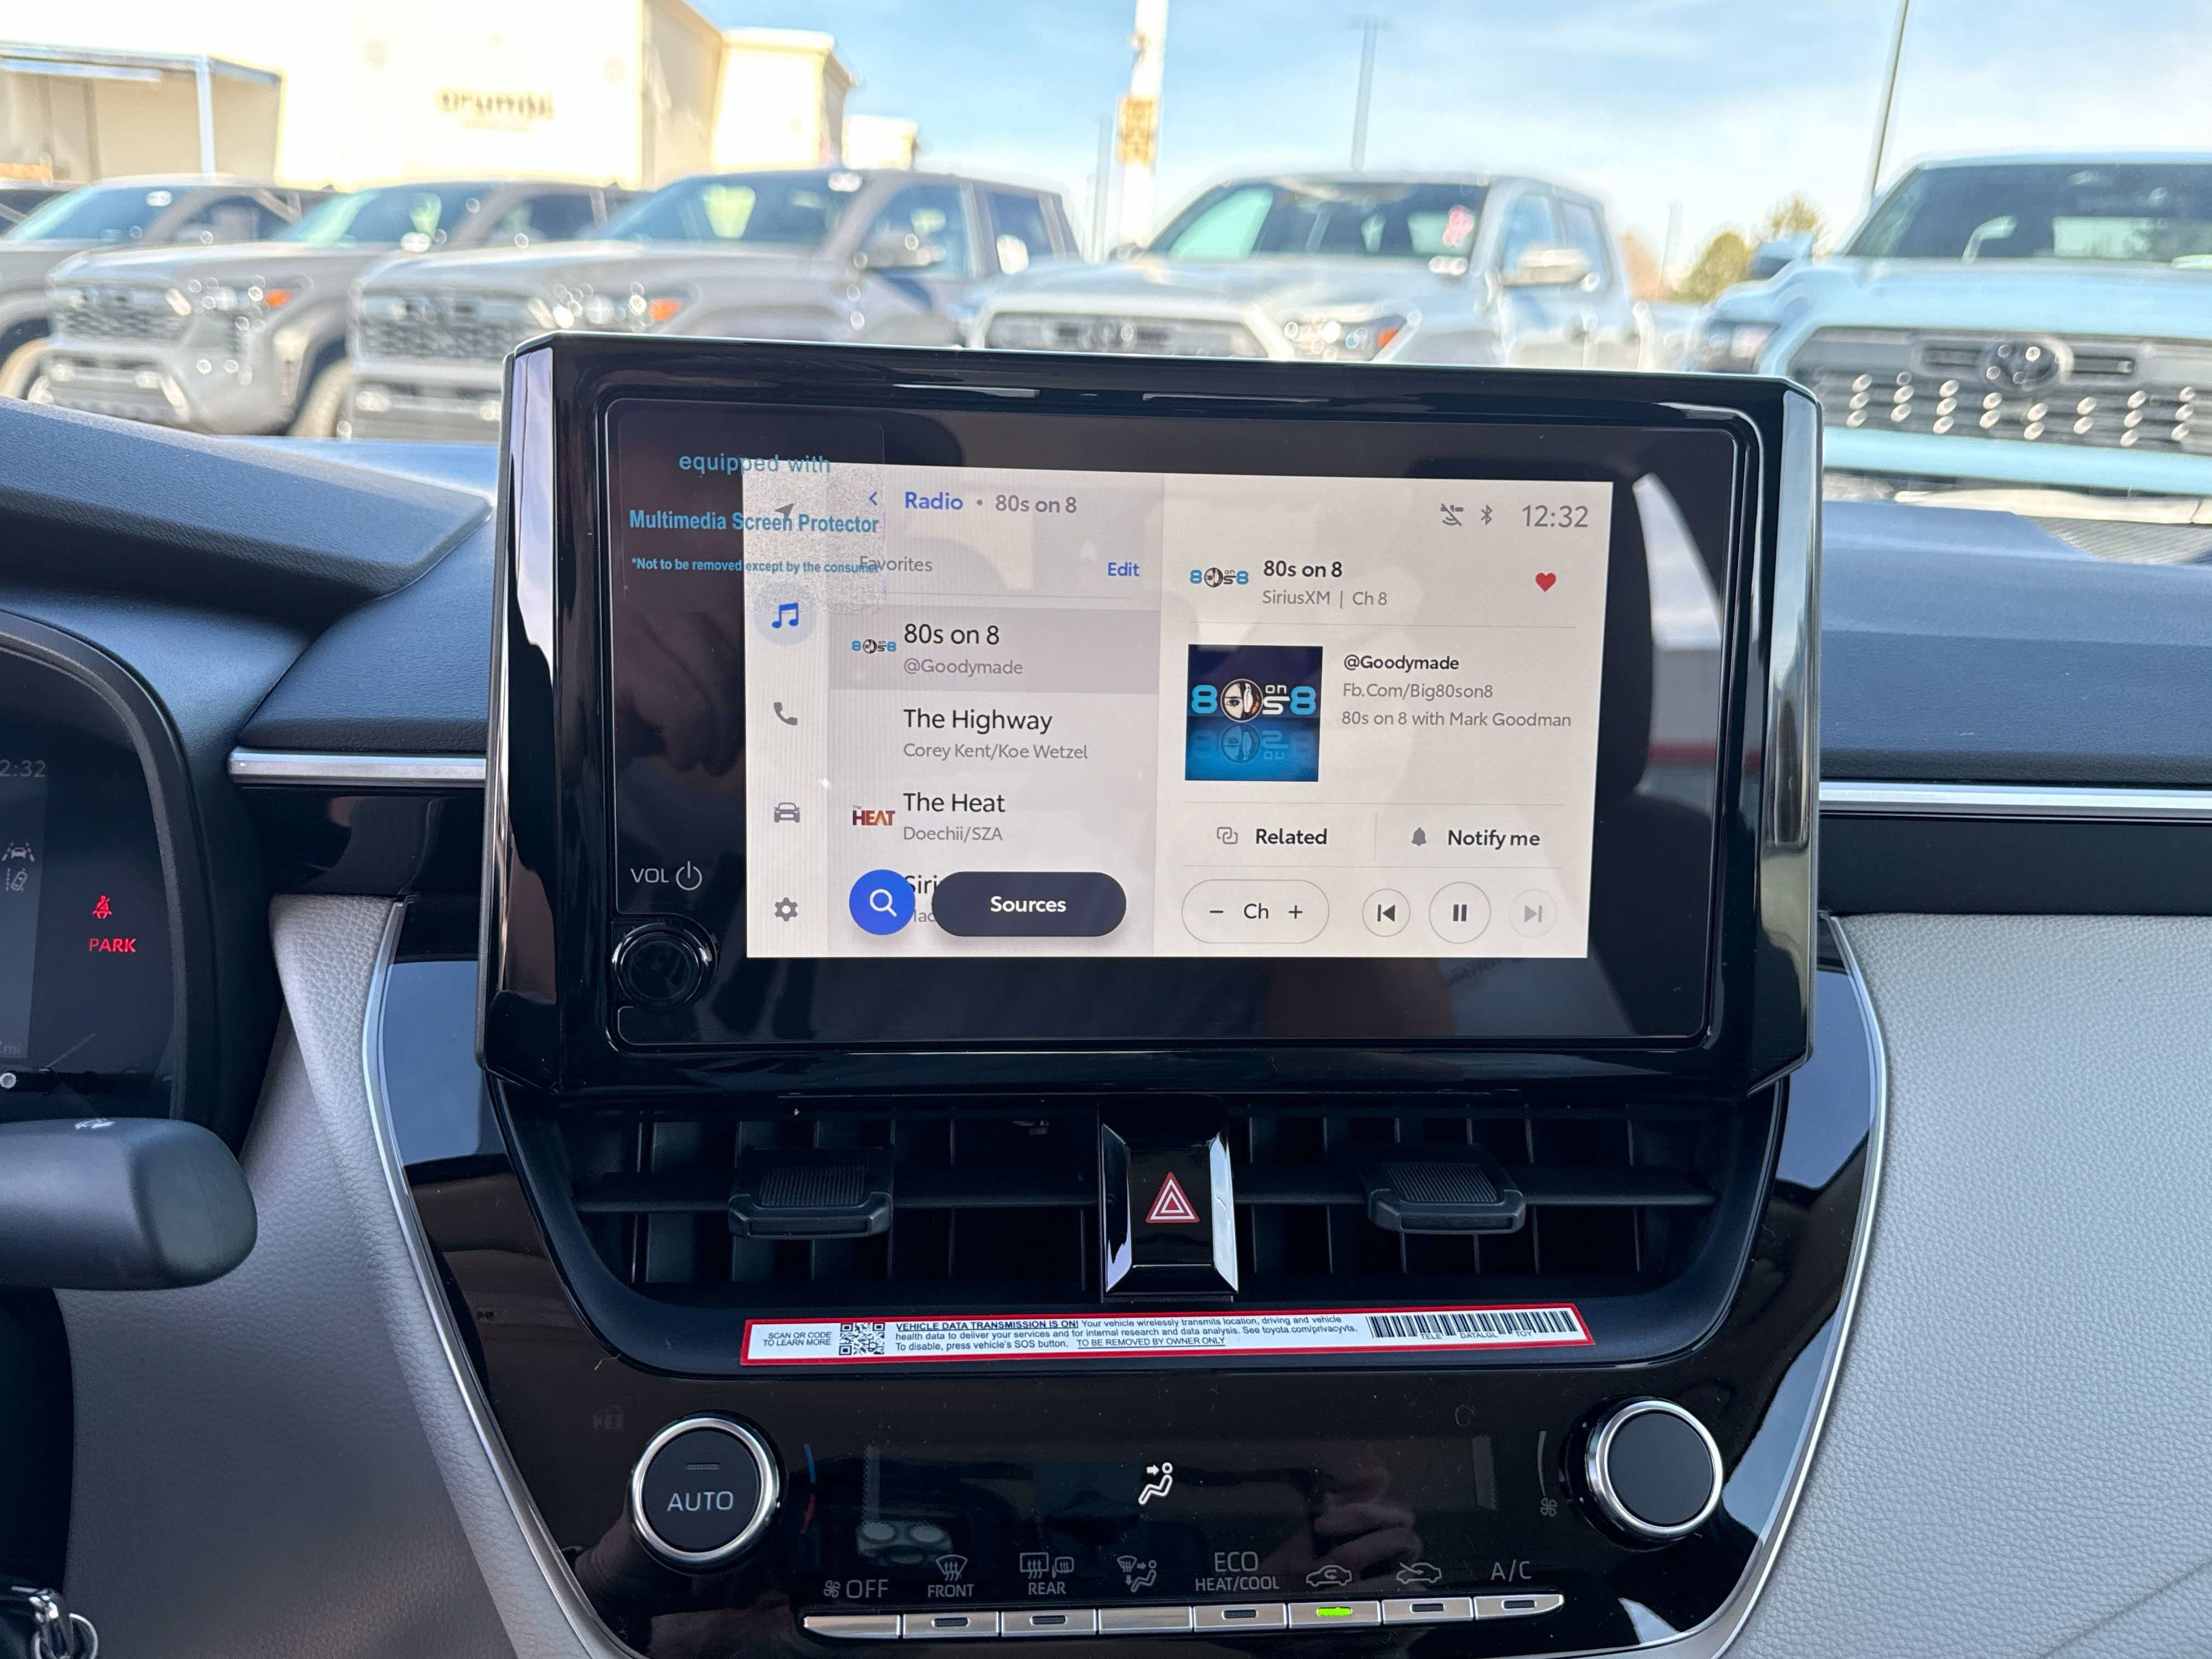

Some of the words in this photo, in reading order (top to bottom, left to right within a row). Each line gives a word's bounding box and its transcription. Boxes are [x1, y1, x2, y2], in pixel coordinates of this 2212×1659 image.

[679, 453, 778, 475] equipped
[788, 455, 830, 473] with
[905, 492, 963, 510] Radio
[996, 495, 1029, 512] 80s
[1035, 500, 1060, 513] on
[1066, 496, 1077, 513] 8
[630, 510, 726, 530] Multimedia
[732, 512, 792, 531] Screen
[799, 514, 879, 533] Protector
[1522, 505, 1589, 528] 12:32
[660, 560, 672, 570] to
[675, 558, 689, 571] be
[692, 560, 742, 571] removed
[746, 561, 783, 574] except
[786, 561, 800, 574] by
[803, 561, 821, 572] the
[860, 556, 933, 572] Favorites
[1108, 562, 1139, 577] Edit
[1263, 561, 1296, 578] 80s
[1302, 565, 1327, 578] on
[1331, 561, 1343, 578] 8
[1262, 589, 1330, 605] SiriusXM
[1352, 591, 1374, 605] Ch
[1378, 591, 1387, 606] 8
[904, 624, 944, 644] 80s
[951, 629, 979, 645] on
[987, 625, 1000, 645] 8
[904, 658, 1023, 678] @Goodymade
[1344, 655, 1459, 673] @Goodymade
[1290, 686, 1316, 715] 8
[1343, 683, 1493, 701] Fb.Com/Big80son8
[904, 709, 945, 728] The
[953, 709, 1053, 735] Highway
[1342, 712, 1369, 725] 80s
[1374, 715, 1393, 725] on
[1398, 712, 1407, 726] 8
[1412, 712, 1445, 726] with
[1450, 712, 1488, 726] Mark
[1492, 712, 1571, 727] Goodman
[904, 743, 951, 761] Corey
[955, 744, 1030, 759] Kent/Koe
[1034, 744, 1088, 759] Wetzel
[903, 793, 944, 812] The
[952, 794, 1006, 812] Heat
[853, 810, 895, 826] HEAT
[904, 826, 1003, 843] Doechii/SZA
[1256, 828, 1328, 845] Related
[1448, 828, 1506, 850] Notify
[1510, 833, 1541, 846] me
[630, 868, 669, 883] VOL
[990, 896, 1066, 913] Sources
[1244, 904, 1269, 920] Ch
[88, 938, 136, 953] PARK
[895, 1323, 939, 1331] VEHICLE
[970, 1321, 1046, 1329] TRANSMISSION
[1137, 1319, 1178, 1328] wirelessly
[1262, 1317, 1290, 1325] driving
[960, 1331, 989, 1339] deliver
[1203, 1327, 1240, 1335] analysis.
[895, 1342, 906, 1351] To
[909, 1342, 943, 1351] disable,
[946, 1343, 971, 1351] press
[973, 1340, 1012, 1348] vehicle's
[1014, 1340, 1035, 1348] SOS
[1038, 1339, 1069, 1347] button.
[667, 1491, 734, 1511] AUTO
[1214, 1551, 1259, 1572] ECO
[1491, 1559, 1532, 1582] A/C
[846, 1579, 888, 1599] OFF
[927, 1584, 974, 1598] FRONT
[1028, 1582, 1066, 1595] REAR
[1195, 1576, 1279, 1592] HEAT/COOL
